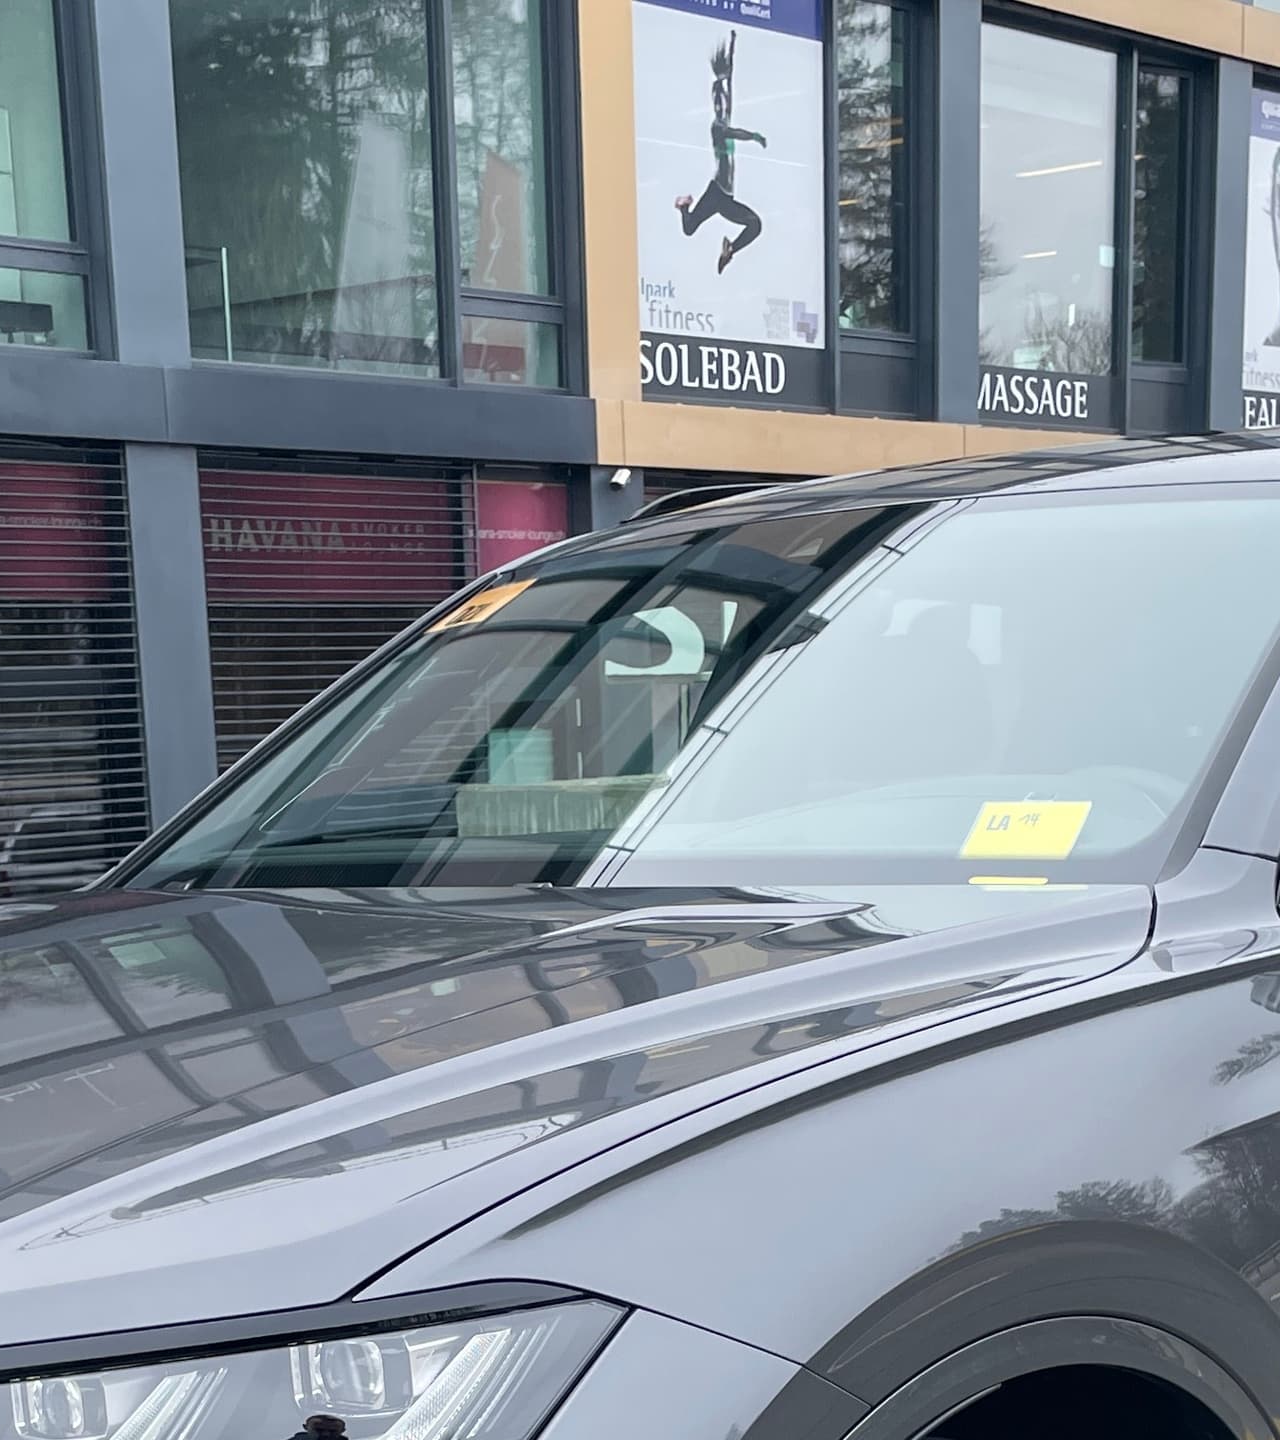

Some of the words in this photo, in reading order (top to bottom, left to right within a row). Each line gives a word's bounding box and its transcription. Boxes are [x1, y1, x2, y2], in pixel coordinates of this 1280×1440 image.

[648, 299, 715, 333] fitness
[640, 340, 786, 394] SOLEBAD
[209, 518, 346, 553] HAVANA
